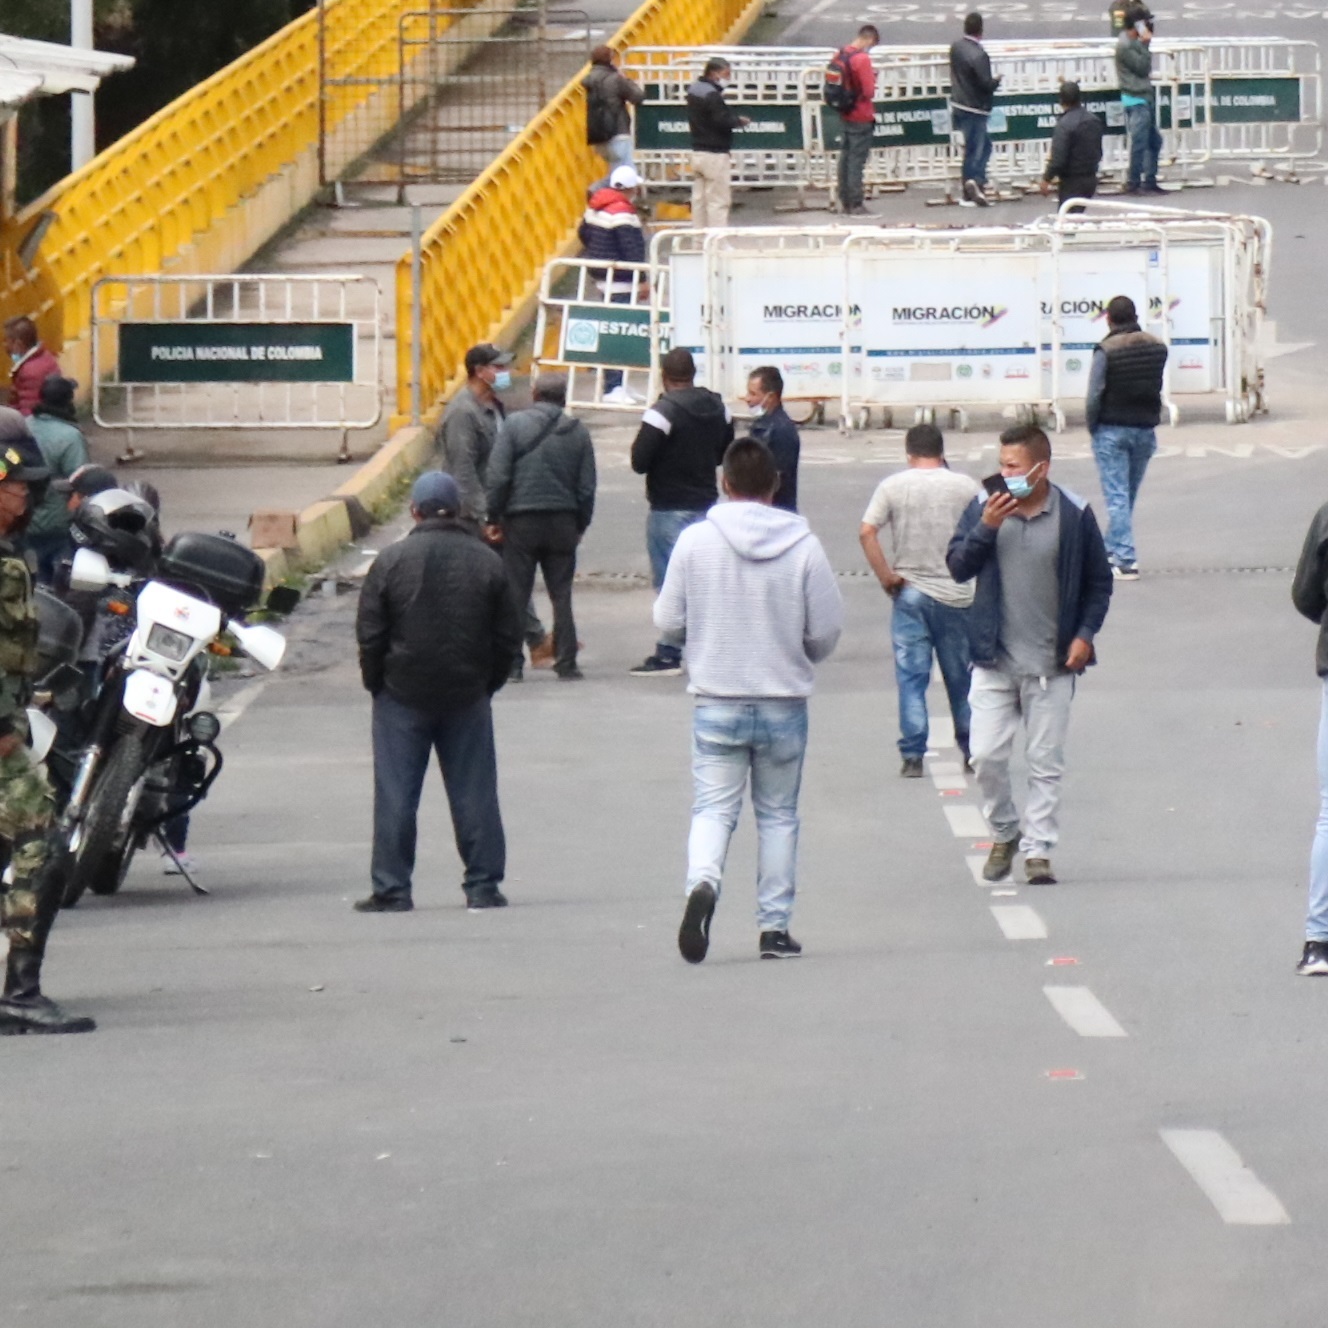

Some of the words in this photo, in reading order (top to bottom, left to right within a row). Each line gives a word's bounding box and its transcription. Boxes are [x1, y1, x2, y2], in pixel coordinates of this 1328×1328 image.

[1233, 95, 1275, 106] COLOMBIA
[896, 110, 931, 123] POLICIA
[892, 304, 996, 321] MIGRACIÓN
[151, 345, 194, 361] POLICIA
[196, 345, 247, 361] NACIONAL
[248, 345, 266, 361] DE
[267, 345, 323, 362] COLOMBIA
